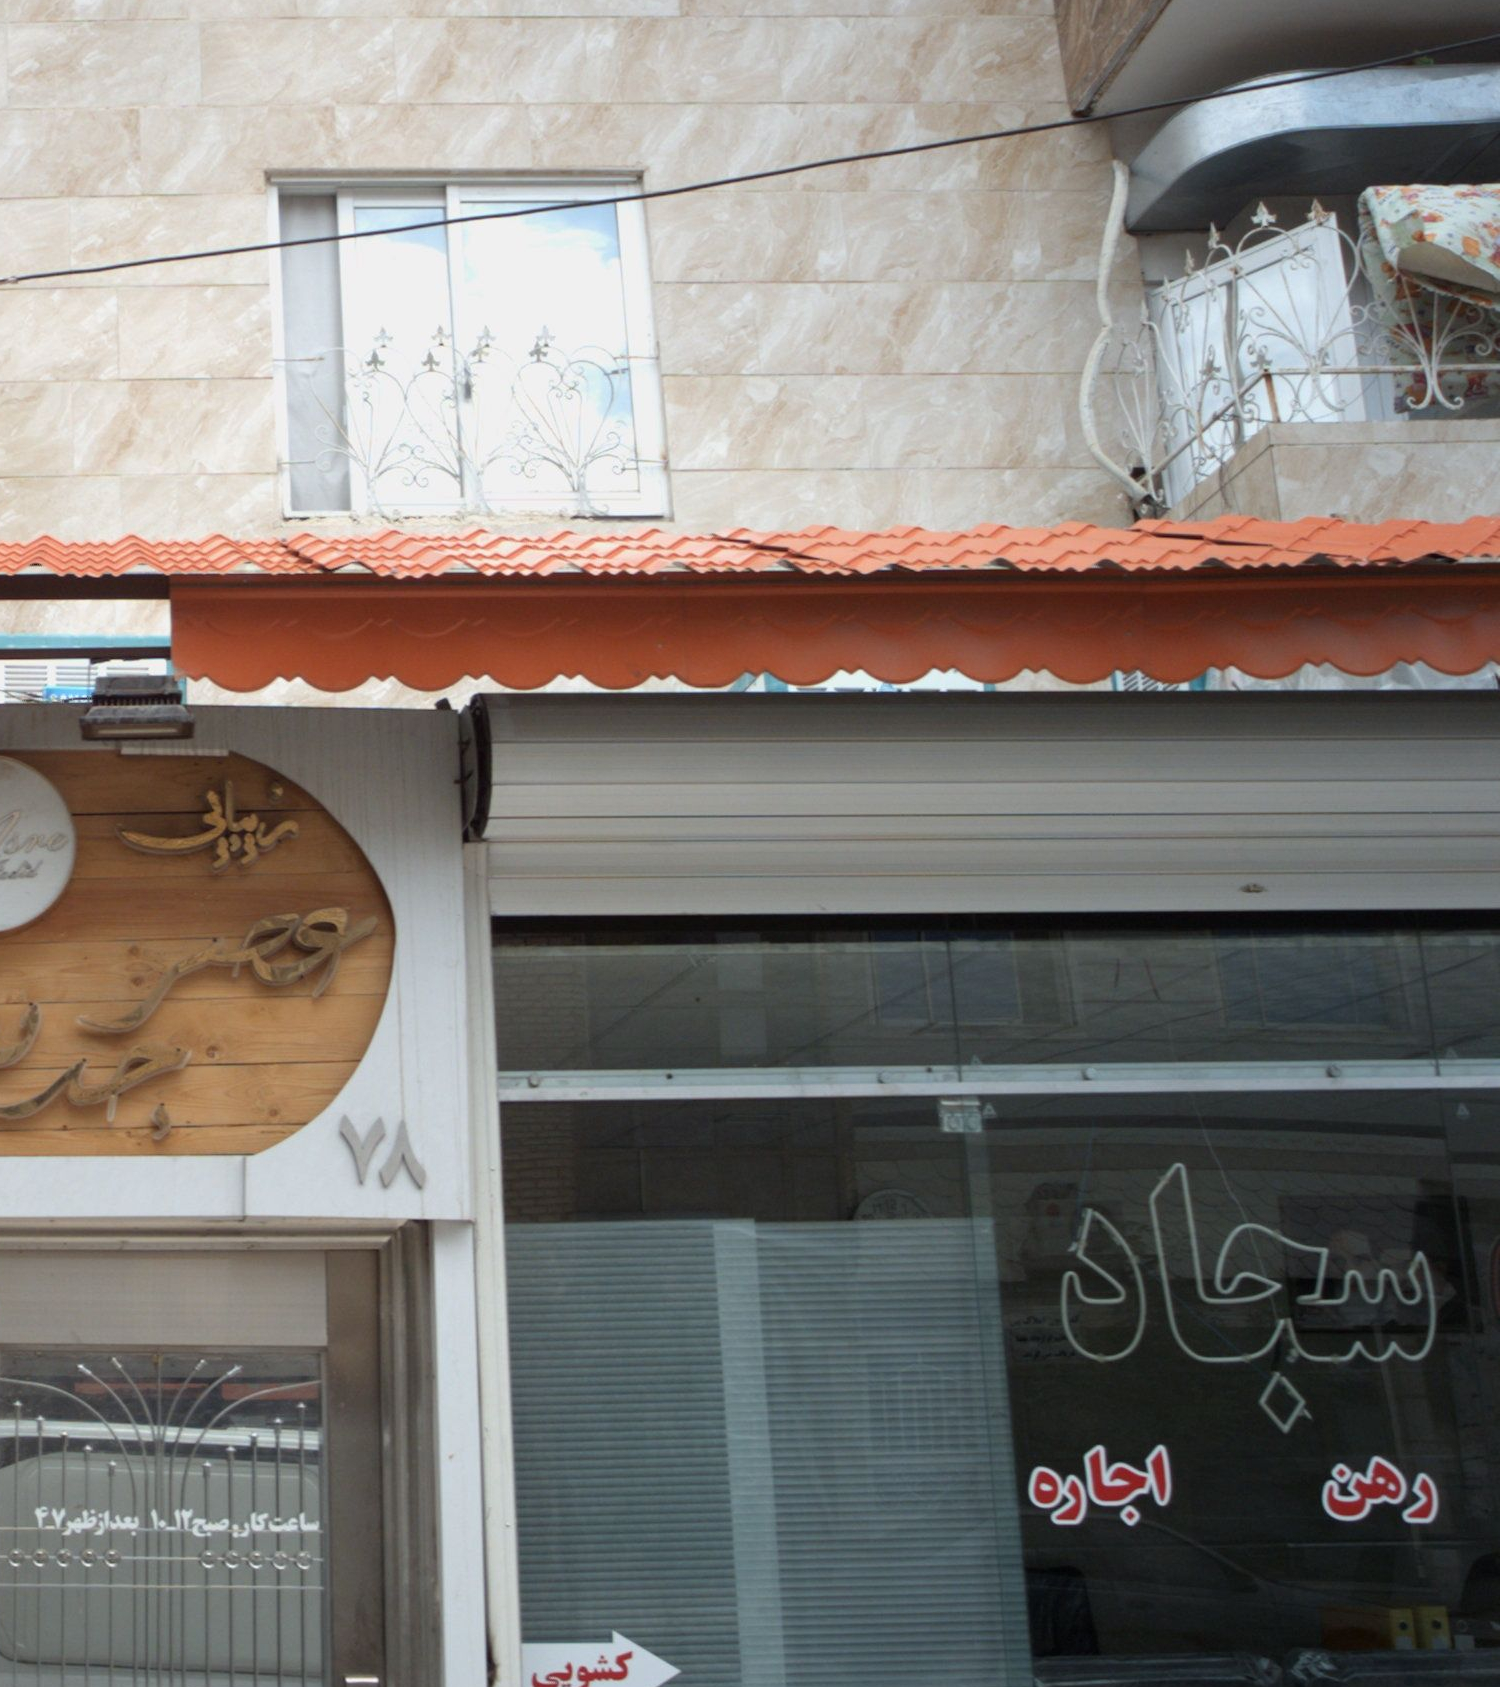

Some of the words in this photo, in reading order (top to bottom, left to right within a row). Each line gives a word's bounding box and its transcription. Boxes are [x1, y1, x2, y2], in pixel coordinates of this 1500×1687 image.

[114, 779, 300, 873] زیبایی
[76, 905, 379, 1037] عصر
[338, 1114, 428, 1191] ۷۸
[1060, 1162, 1437, 1434] سجاد
[1028, 1443, 1172, 1527] اجاره
[1322, 1454, 1440, 1525] رهن
[531, 1651, 634, 1687] کشویی
